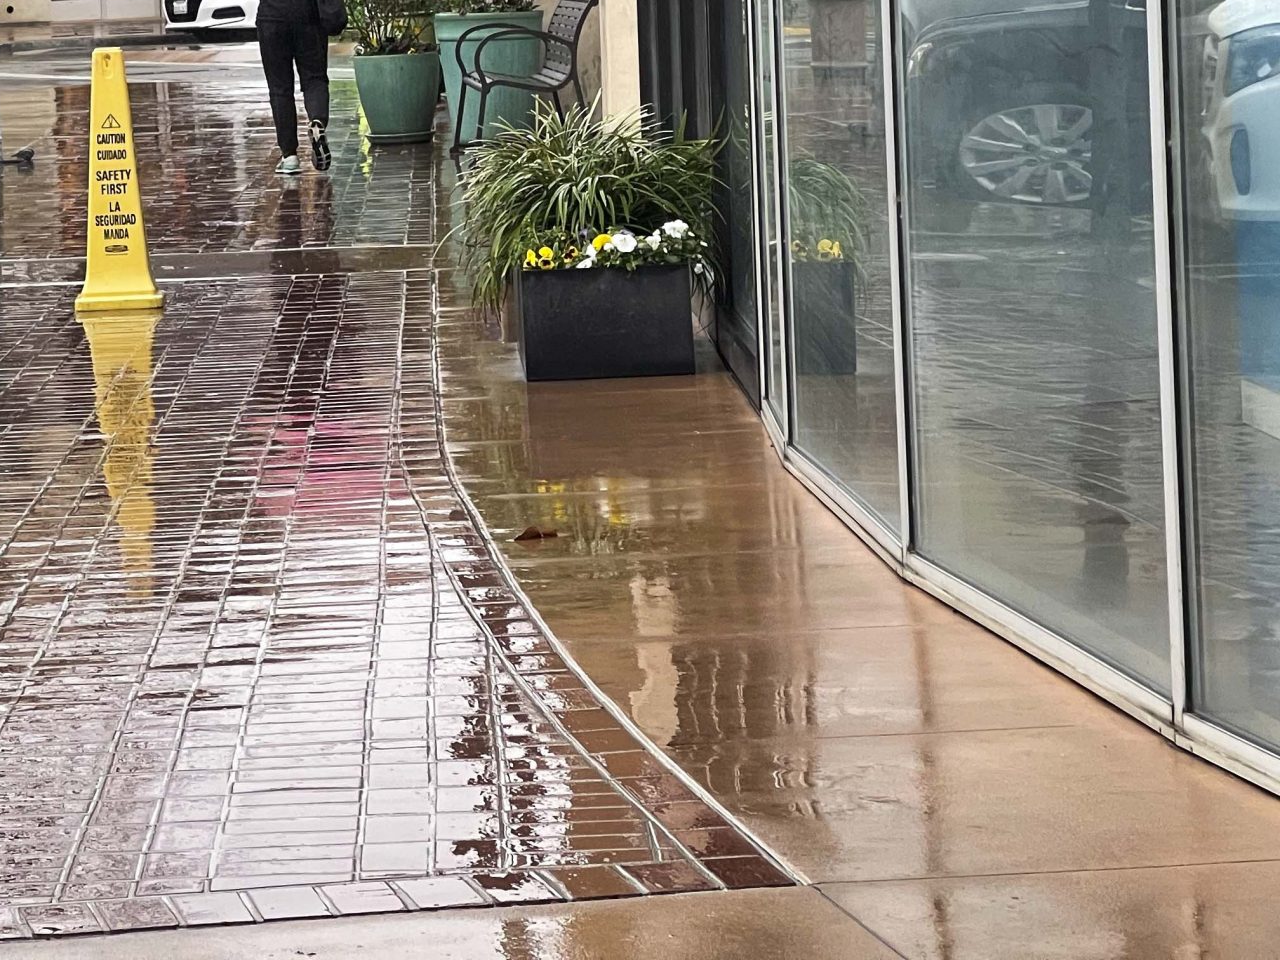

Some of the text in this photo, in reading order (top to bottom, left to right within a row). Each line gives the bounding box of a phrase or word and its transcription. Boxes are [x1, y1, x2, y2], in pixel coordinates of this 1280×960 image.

[96, 133, 126, 145] CAUTION
[97, 149, 127, 160] CUIDADO
[96, 169, 131, 181] SAFETY
[101, 183, 127, 195] FIRST
[109, 201, 121, 212] LA
[95, 214, 136, 226] SEGURIDAD
[104, 228, 129, 240] MANDA
